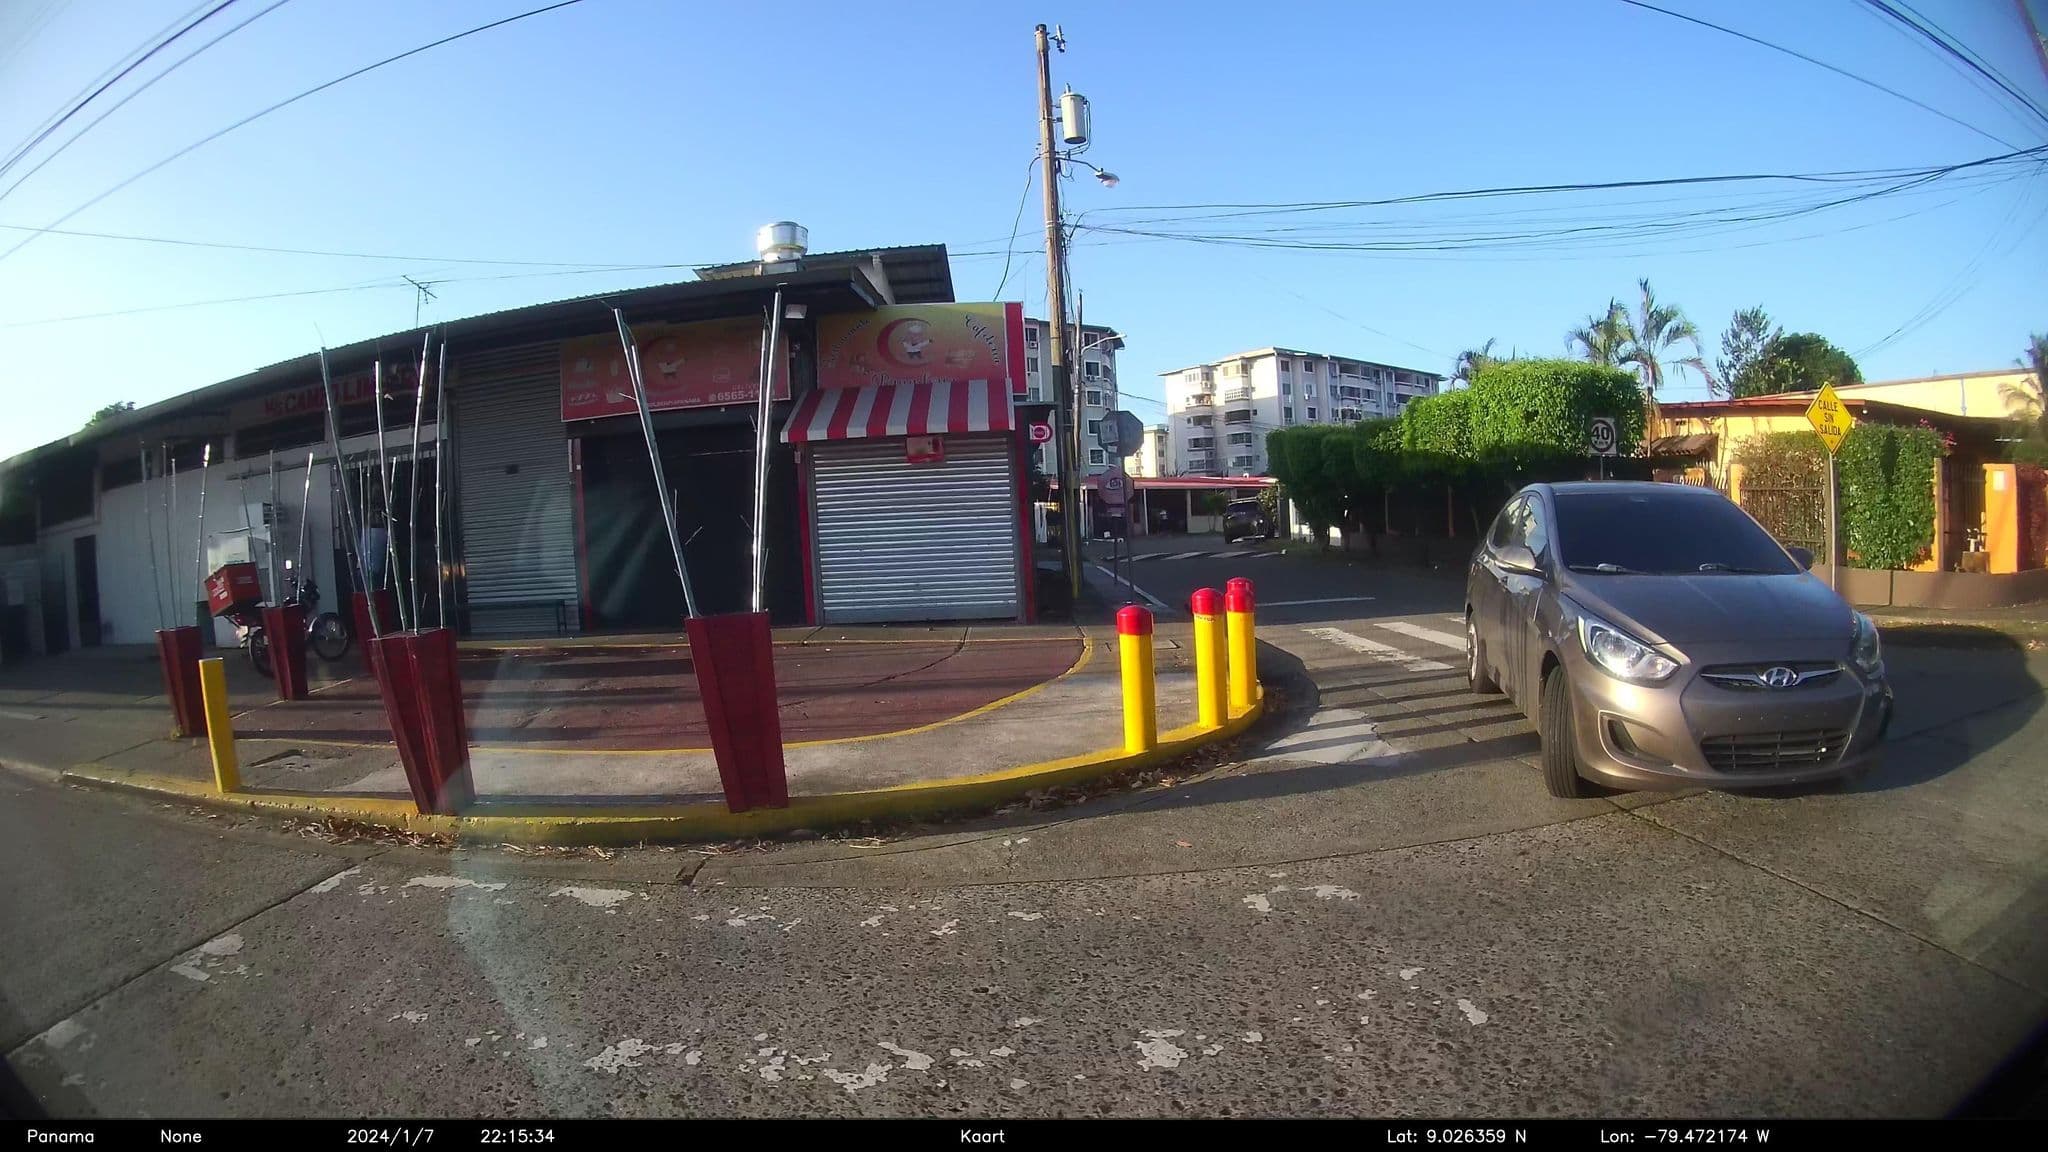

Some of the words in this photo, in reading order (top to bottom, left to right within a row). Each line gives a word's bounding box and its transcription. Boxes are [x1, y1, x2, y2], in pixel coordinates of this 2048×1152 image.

[1818, 400, 1838, 412] CALLE
[1823, 412, 1835, 424] SIN
[1591, 426, 1609, 440] 40
[1819, 424, 1841, 436] SALIDA
